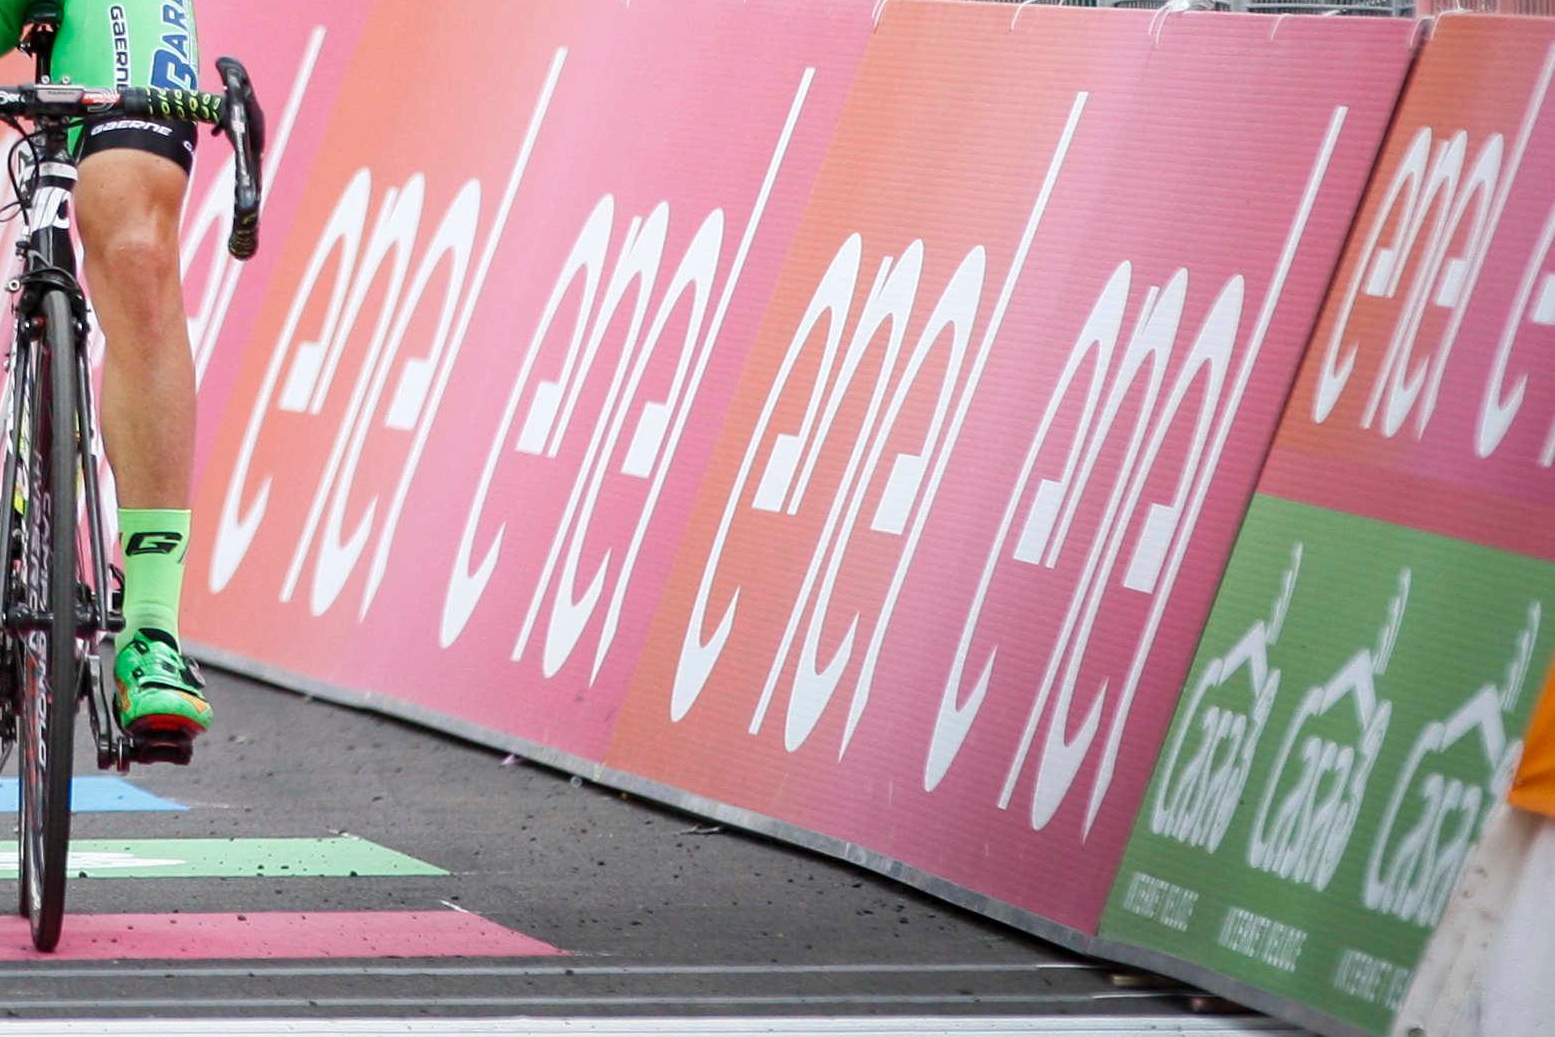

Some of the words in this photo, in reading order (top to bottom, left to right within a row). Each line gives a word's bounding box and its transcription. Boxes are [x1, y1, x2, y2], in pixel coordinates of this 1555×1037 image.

[209, 46, 568, 624] enel
[440, 68, 816, 688] enel
[670, 91, 1089, 762] enel
[925, 106, 1349, 845] enel
[1312, 39, 1555, 440] enel
